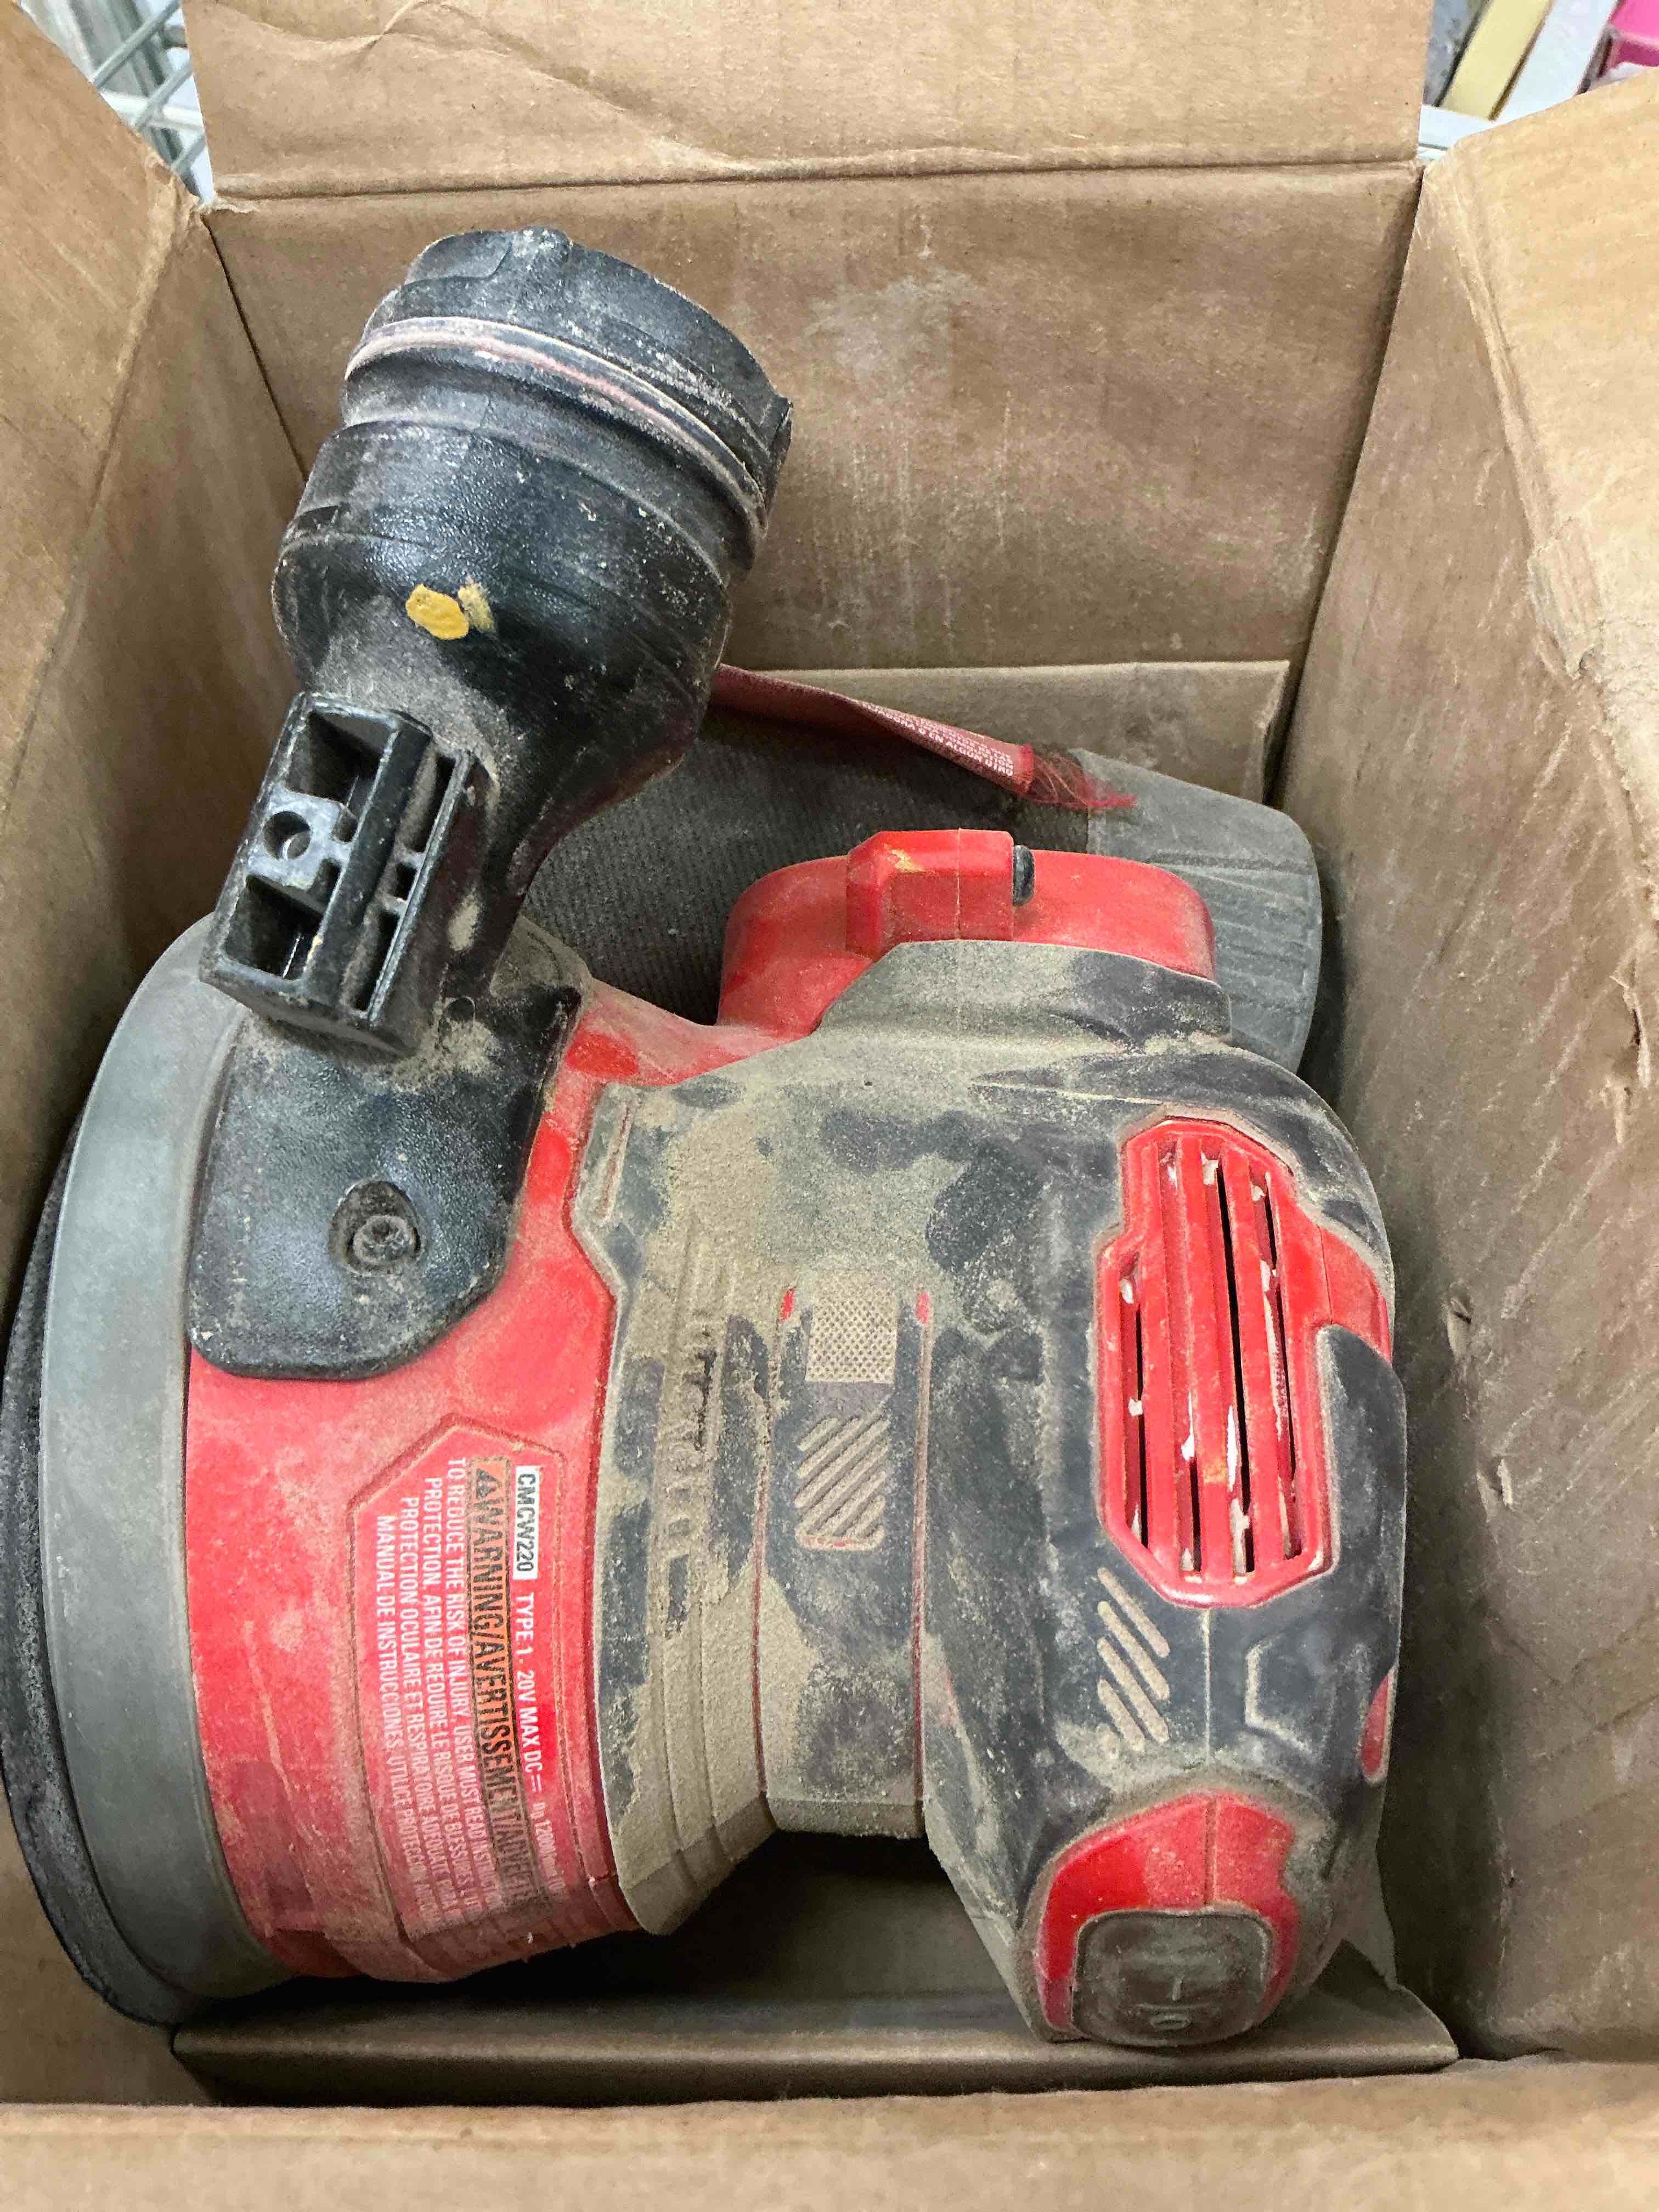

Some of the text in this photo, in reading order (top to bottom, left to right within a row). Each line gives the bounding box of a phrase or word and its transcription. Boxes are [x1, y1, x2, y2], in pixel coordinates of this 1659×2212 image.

[447, 1457, 466, 1480] TO
[445, 1484, 466, 1555] REDUCE
[516, 1473, 537, 1572] CMCW220
[376, 1515, 396, 1592] MANUAL
[399, 1497, 420, 1604] PROTECTION
[445, 1559, 465, 1589] THE
[377, 1595, 396, 1617] DE
[423, 1594, 442, 1636] AFIN
[445, 1594, 465, 1632] RISK
[515, 1592, 534, 1641] TYPE
[399, 1608, 422, 1688] OCULAIRE
[424, 1638, 444, 1658] DE
[447, 1635, 466, 1660] OF
[515, 1646, 534, 1655] 1
[404, 1691, 424, 1710] ET
[516, 1669, 537, 1702] 20V
[431, 1731, 450, 1748] LE
[454, 1725, 475, 1764] USER
[518, 1707, 541, 1748] MAX
[387, 1756, 413, 1805] UTILICE
[407, 1713, 436, 1812] RESPIRATOIRE
[433, 1751, 458, 1802] RISQUE
[523, 1750, 544, 1774] DC
[457, 1765, 482, 1805] MUST
[440, 1803, 461, 1820] DE
[465, 1807, 488, 1839] READ
